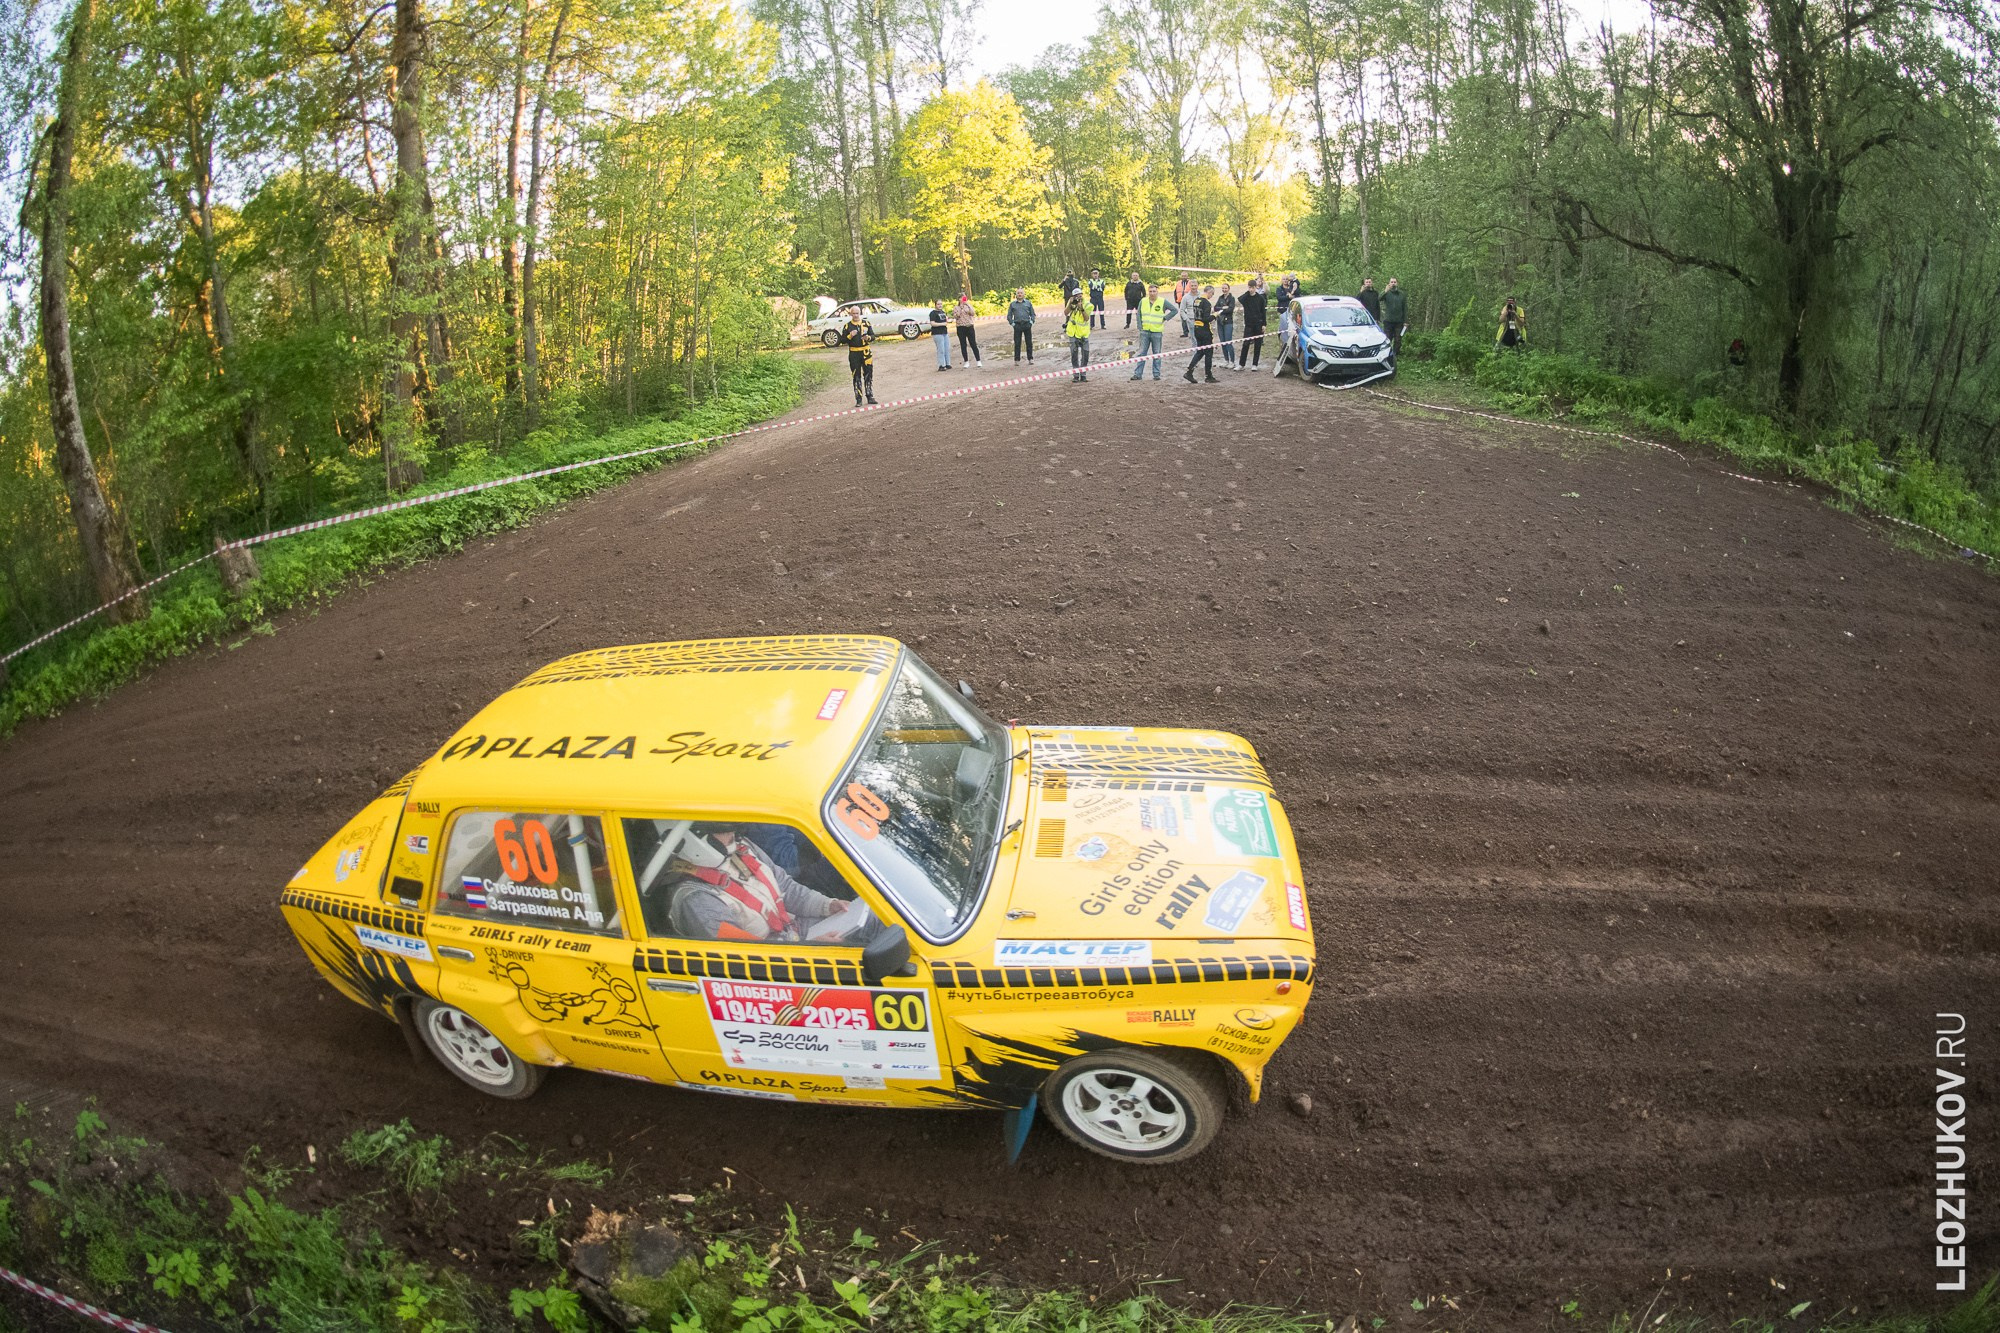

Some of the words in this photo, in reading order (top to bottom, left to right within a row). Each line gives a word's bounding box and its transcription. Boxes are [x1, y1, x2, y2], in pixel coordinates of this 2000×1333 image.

[819, 690, 847, 719] MOTUL
[483, 736, 636, 760] PLAZA
[650, 732, 794, 763] Sport
[417, 802, 440, 813] RALLY
[836, 782, 890, 841] 60
[494, 819, 558, 884] 60
[1079, 871, 1131, 917] Girls
[1128, 838, 1170, 878] only
[1124, 858, 1185, 916] edition
[483, 879, 558, 900] Стебихова
[561, 887, 592, 904] Оля
[1155, 874, 1212, 930] rally
[489, 896, 570, 919] Затравкина
[574, 906, 604, 922] Аля
[1290, 887, 1306, 928] MOTUL
[360, 928, 426, 951] МАСТЕР
[470, 926, 515, 942] 2GIRLS
[518, 934, 551, 949] rally
[556, 939, 592, 953] team
[1001, 942, 1146, 955] МАСТЕР
[485, 946, 535, 963] CO-DRIVER
[1086, 956, 1140, 965] СПОРТ
[711, 982, 733, 999] 80
[734, 986, 793, 1002] ПОБЕДА!
[947, 988, 1135, 1002] #чутьбыстрееавтобуса
[716, 999, 777, 1025] 1945
[802, 1005, 870, 1031] 2025
[874, 994, 925, 1031] 60
[1153, 1009, 1196, 1022] RALLY
[604, 1027, 642, 1039] DRIVER
[759, 1031, 819, 1043] РАЛЛИ
[1216, 1023, 1272, 1045] ПСКОВ-ЛАДА
[571, 1035, 651, 1055] #wheelsisters
[758, 1040, 830, 1053] РОССИИ
[724, 1073, 794, 1090] PLAZA
[799, 1081, 848, 1094] Sport
